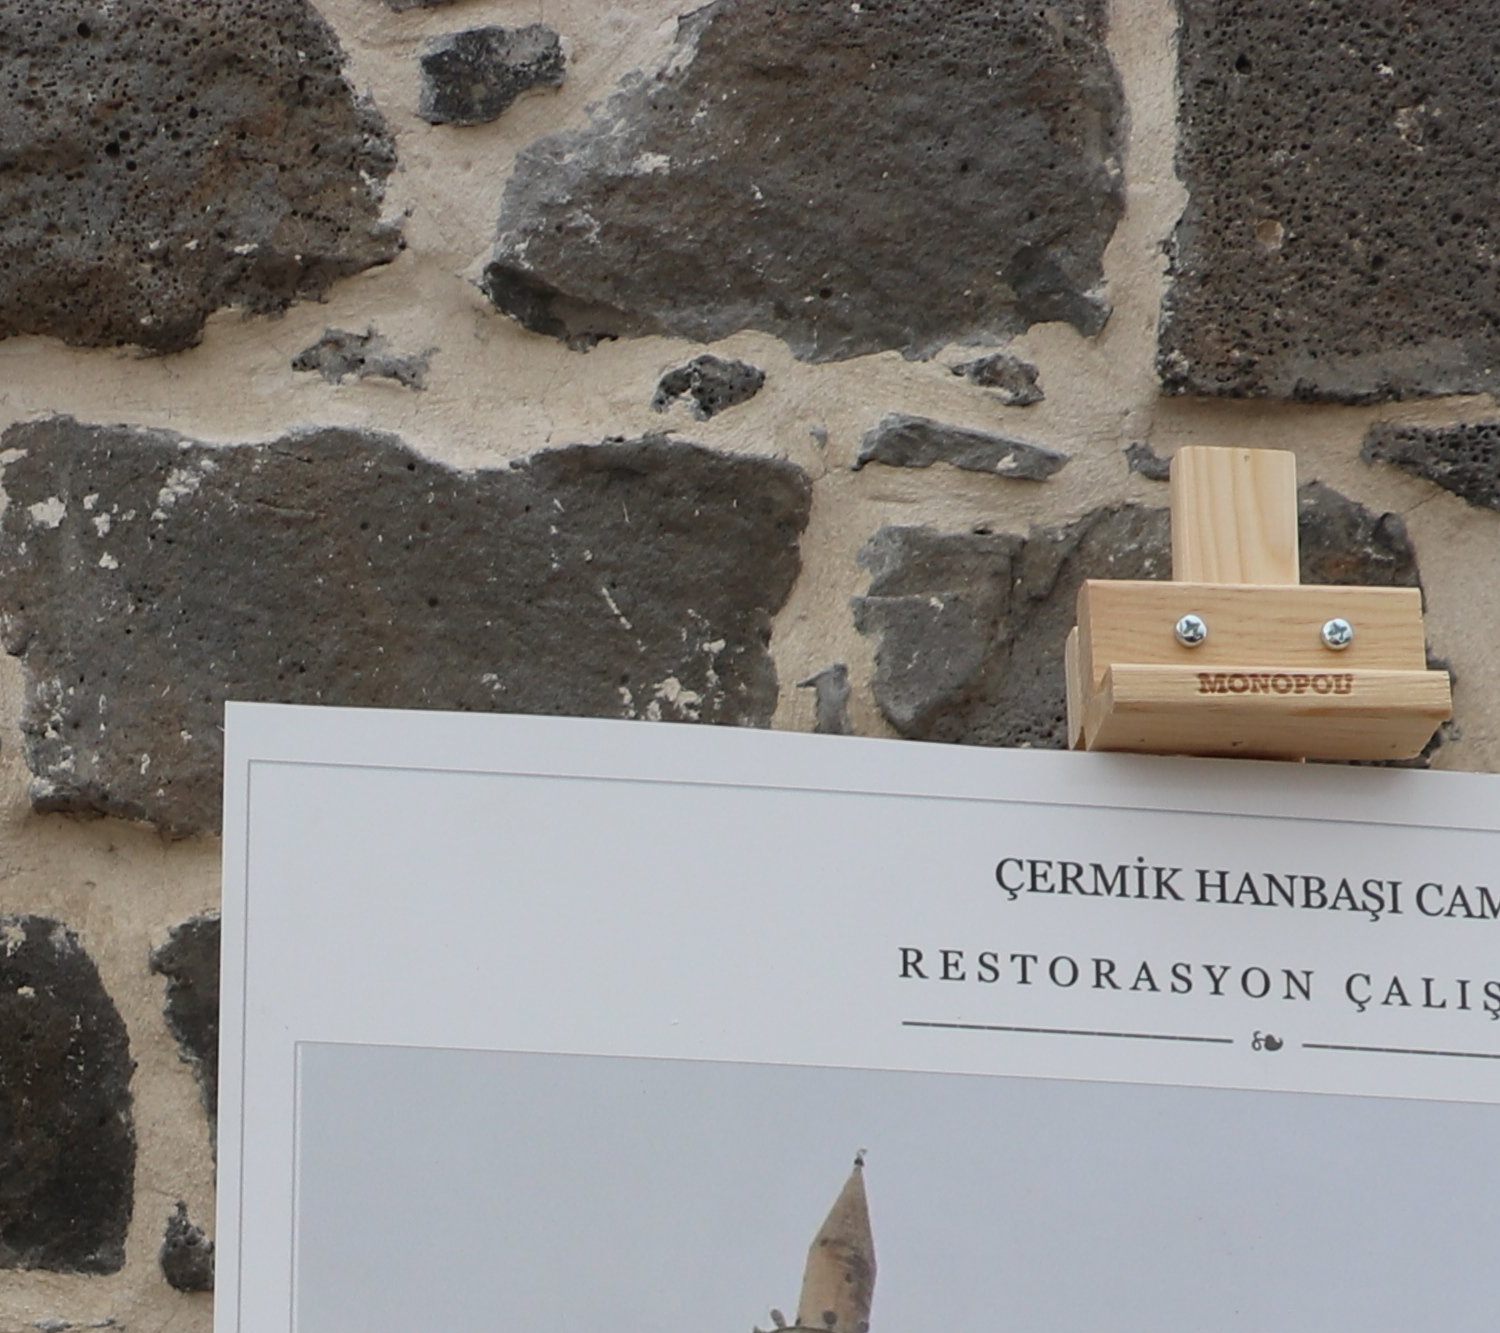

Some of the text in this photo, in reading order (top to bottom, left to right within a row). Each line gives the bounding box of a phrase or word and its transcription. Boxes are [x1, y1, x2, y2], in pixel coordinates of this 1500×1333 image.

[995, 855, 1185, 902] ÇERMİK
[1195, 868, 1404, 923] HANBAŞI
[898, 947, 1315, 1001] RESTORASYON
